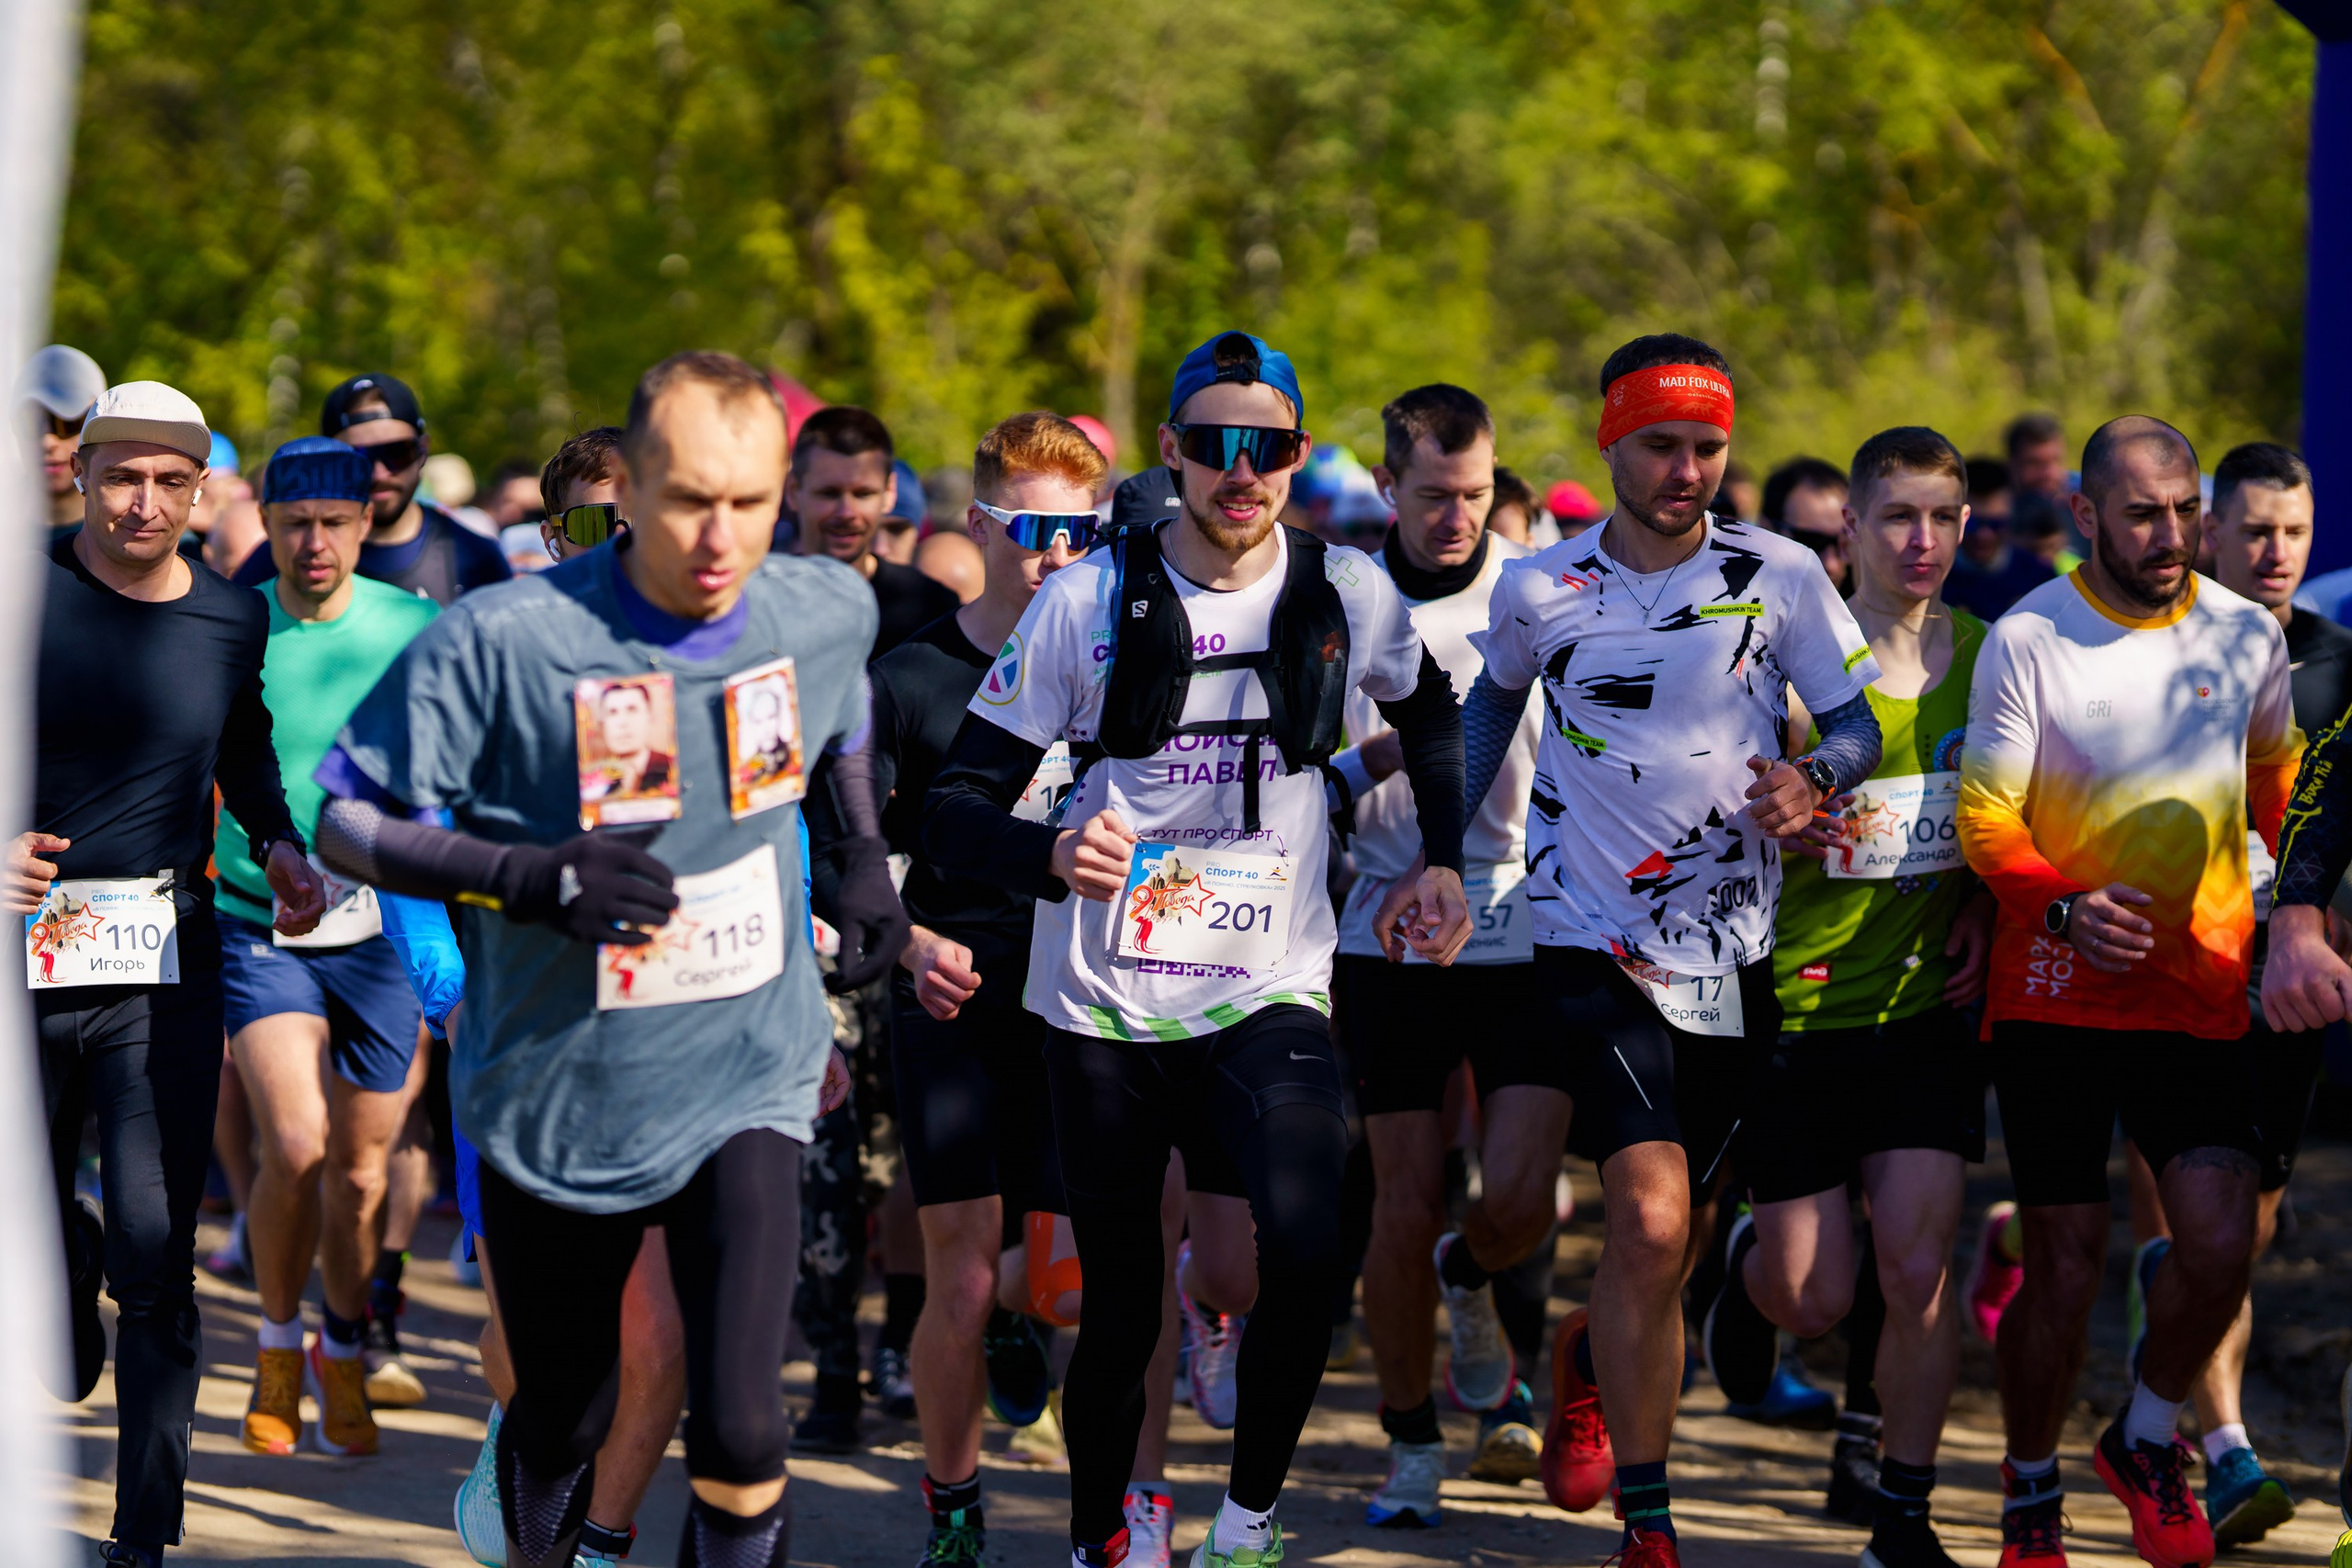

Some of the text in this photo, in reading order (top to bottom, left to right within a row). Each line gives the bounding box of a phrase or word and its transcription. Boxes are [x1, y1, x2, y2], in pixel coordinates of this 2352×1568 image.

[1659, 376, 1731, 400] MAD FOX ULTRA
[1701, 606, 1745, 615] KHROMUSHKIN
[1193, 633, 1226, 655] 40
[1041, 756, 1059, 764] ОРТ
[1152, 828, 1273, 841] ТУТ ПРО СПОРТ
[1899, 815, 1956, 844] 106
[1865, 848, 1956, 866] Александр
[1205, 867, 1259, 880] СПОРТ 40
[92, 894, 126, 902] СПОРТ
[1719, 875, 1757, 913] 007
[1208, 901, 1272, 933] 201
[1479, 904, 1513, 930] 57
[106, 923, 162, 951] 110
[703, 914, 764, 959] 118
[90, 957, 145, 973] Игорь
[1690, 976, 1724, 1001] 17
[1661, 1003, 1721, 1022] Сергей
